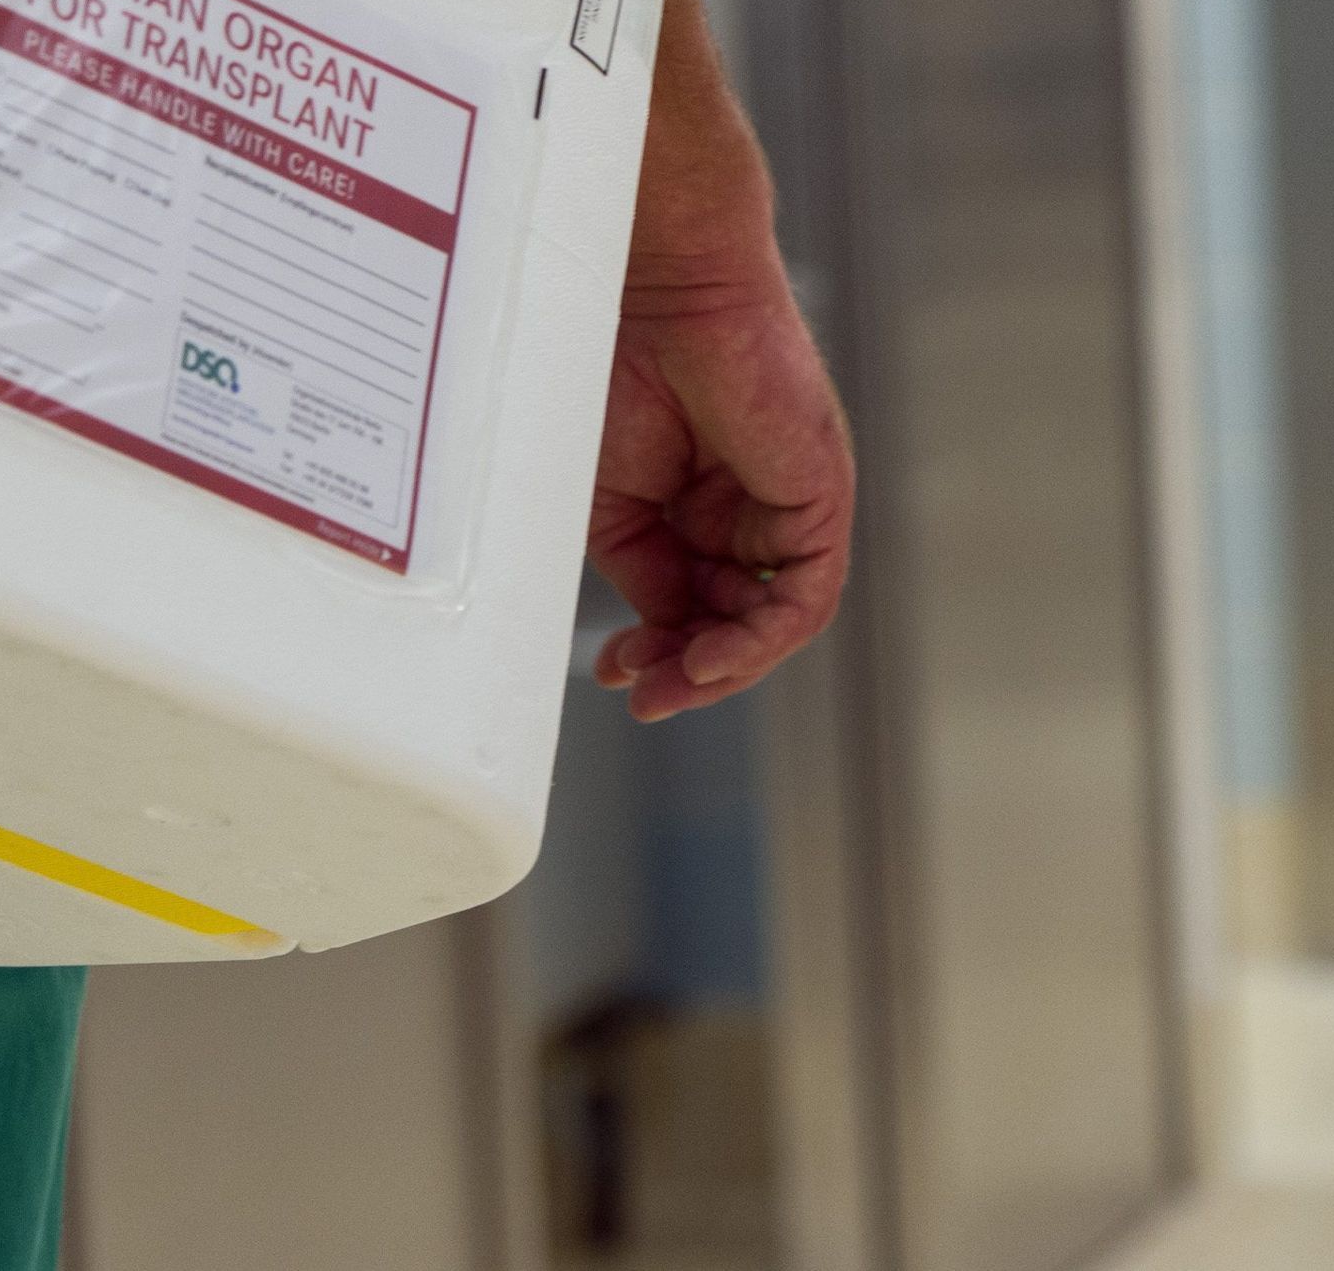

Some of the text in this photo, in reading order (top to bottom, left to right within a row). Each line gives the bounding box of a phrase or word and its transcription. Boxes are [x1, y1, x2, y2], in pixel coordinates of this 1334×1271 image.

[22, 27, 115, 89] PLEASE
[119, 72, 215, 136] HANDLE
[222, 118, 282, 167] WITH
[286, 151, 357, 200] CARE!
[121, 10, 375, 158] TRANSPLANT
[223, 11, 378, 112] ORGAN
